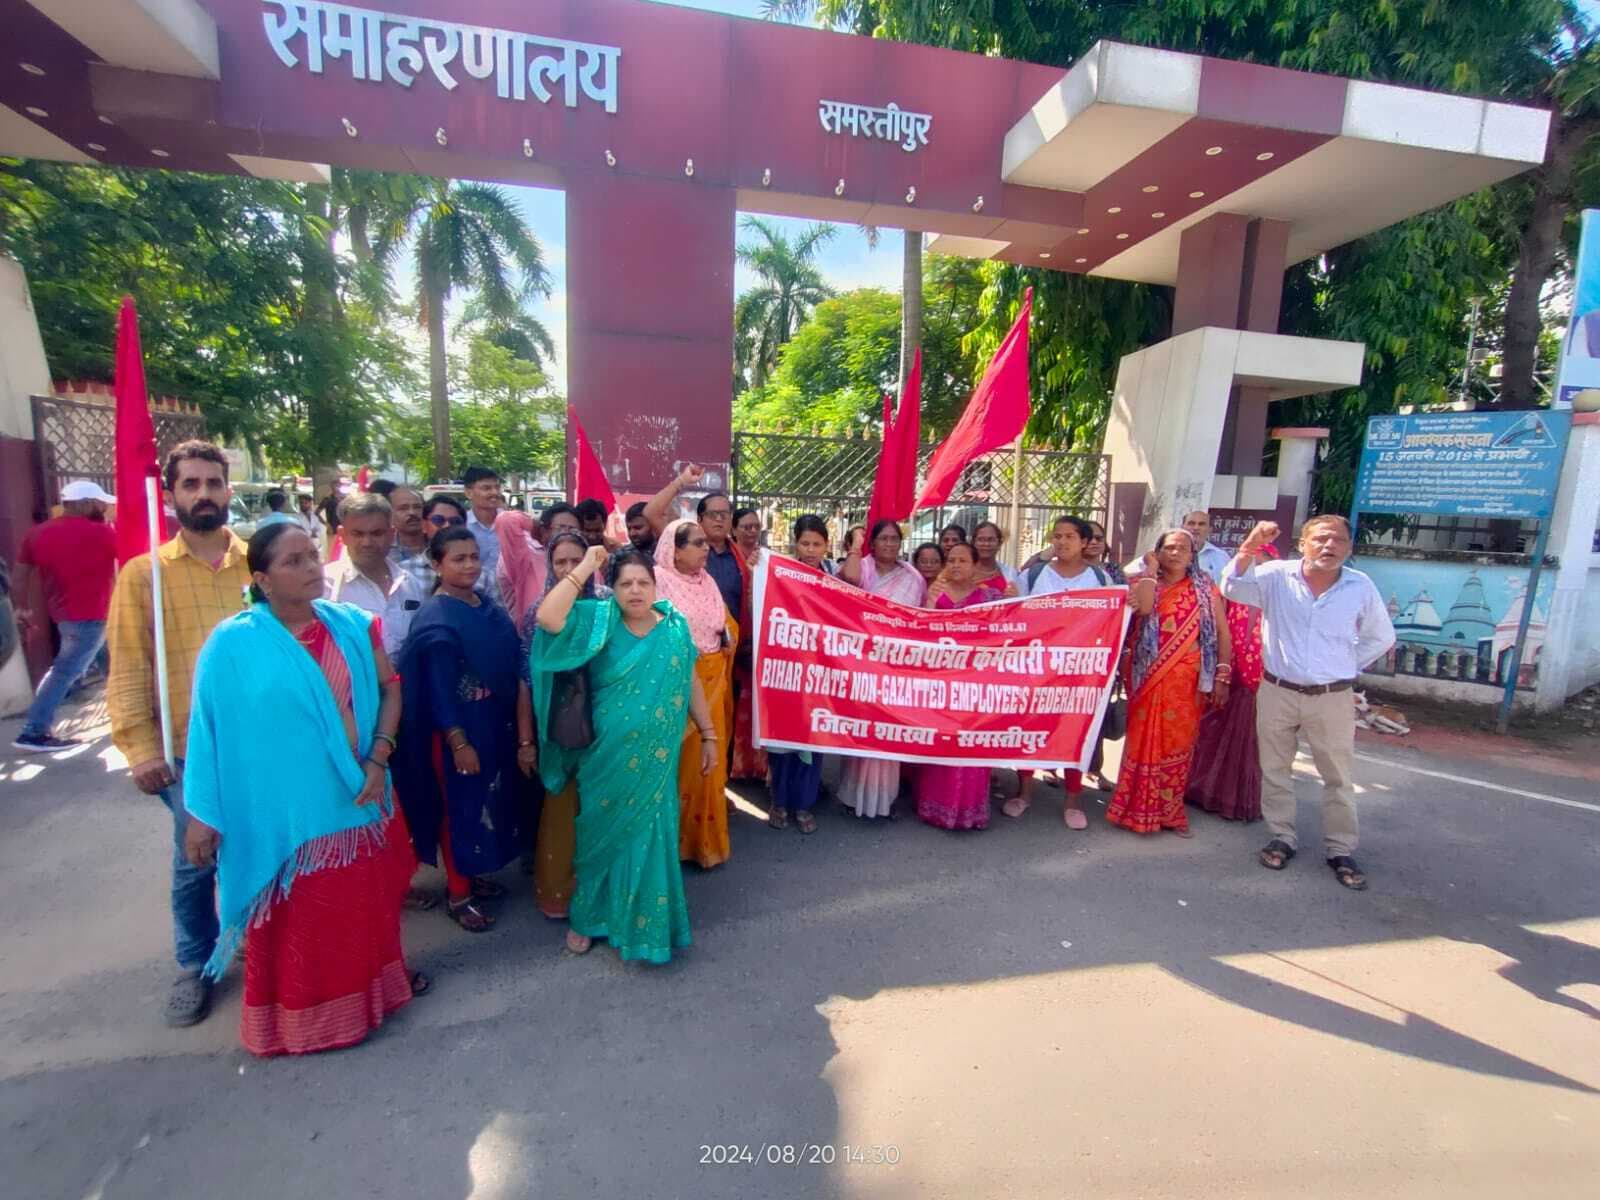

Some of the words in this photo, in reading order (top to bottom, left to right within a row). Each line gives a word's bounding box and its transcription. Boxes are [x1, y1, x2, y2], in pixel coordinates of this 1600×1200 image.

[262, 0, 622, 113] समाहरणालय
[819, 99, 932, 152] समस्तीपुर
[1435, 451, 1472, 461] 2019
[767, 607, 822, 653] बिहार
[822, 624, 868, 660] राज्य
[868, 635, 974, 669] अराजपत्रित
[1047, 638, 1112, 676] महासंघ
[761, 658, 803, 693] BIHAR
[805, 663, 850, 698] STATE
[850, 672, 947, 710] NON-GAZATTED
[810, 708, 871, 738] जिला
[874, 721, 938, 745] शाखा
[957, 726, 1050, 754] समस्तीपुर
